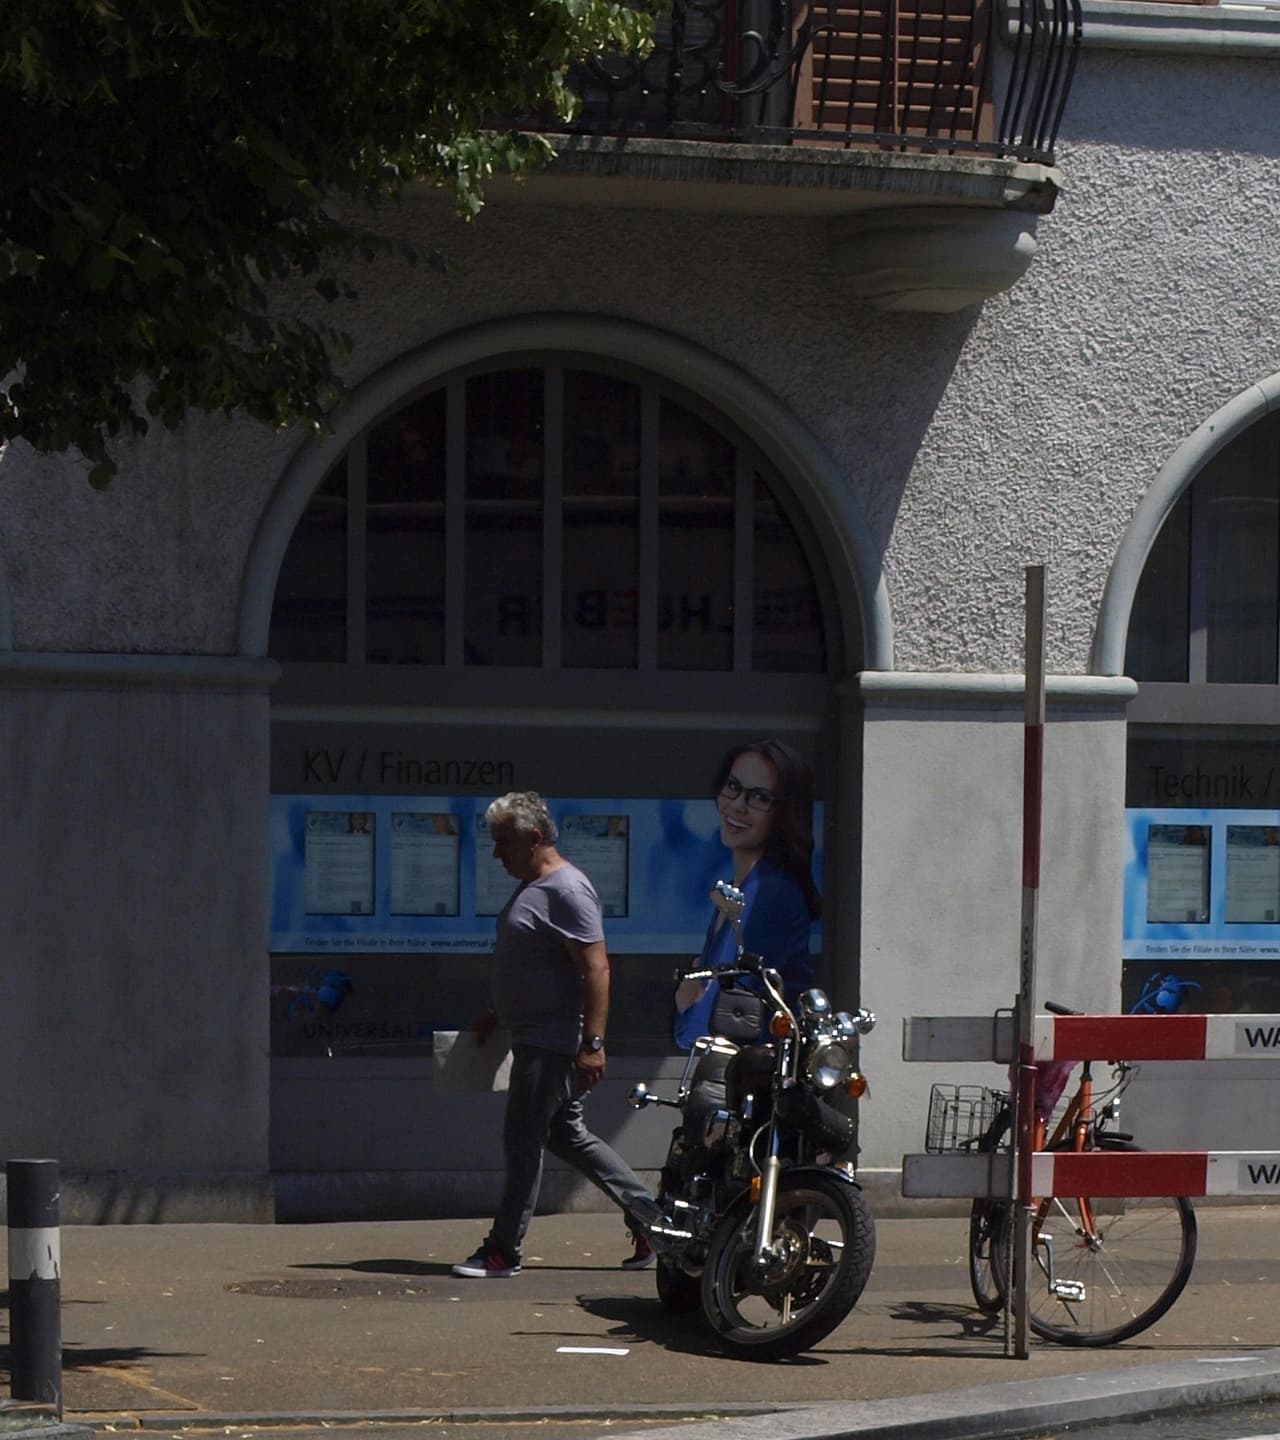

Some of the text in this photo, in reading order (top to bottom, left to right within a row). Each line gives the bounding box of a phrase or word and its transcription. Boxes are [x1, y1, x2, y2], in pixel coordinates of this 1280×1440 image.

[303, 750, 515, 785] KV / Finanzen
[1148, 764, 1255, 800] Technik
[1264, 766, 1276, 799] /
[1022, 926, 1033, 1001] WALO
[303, 1023, 417, 1040] UNIVERSAL
